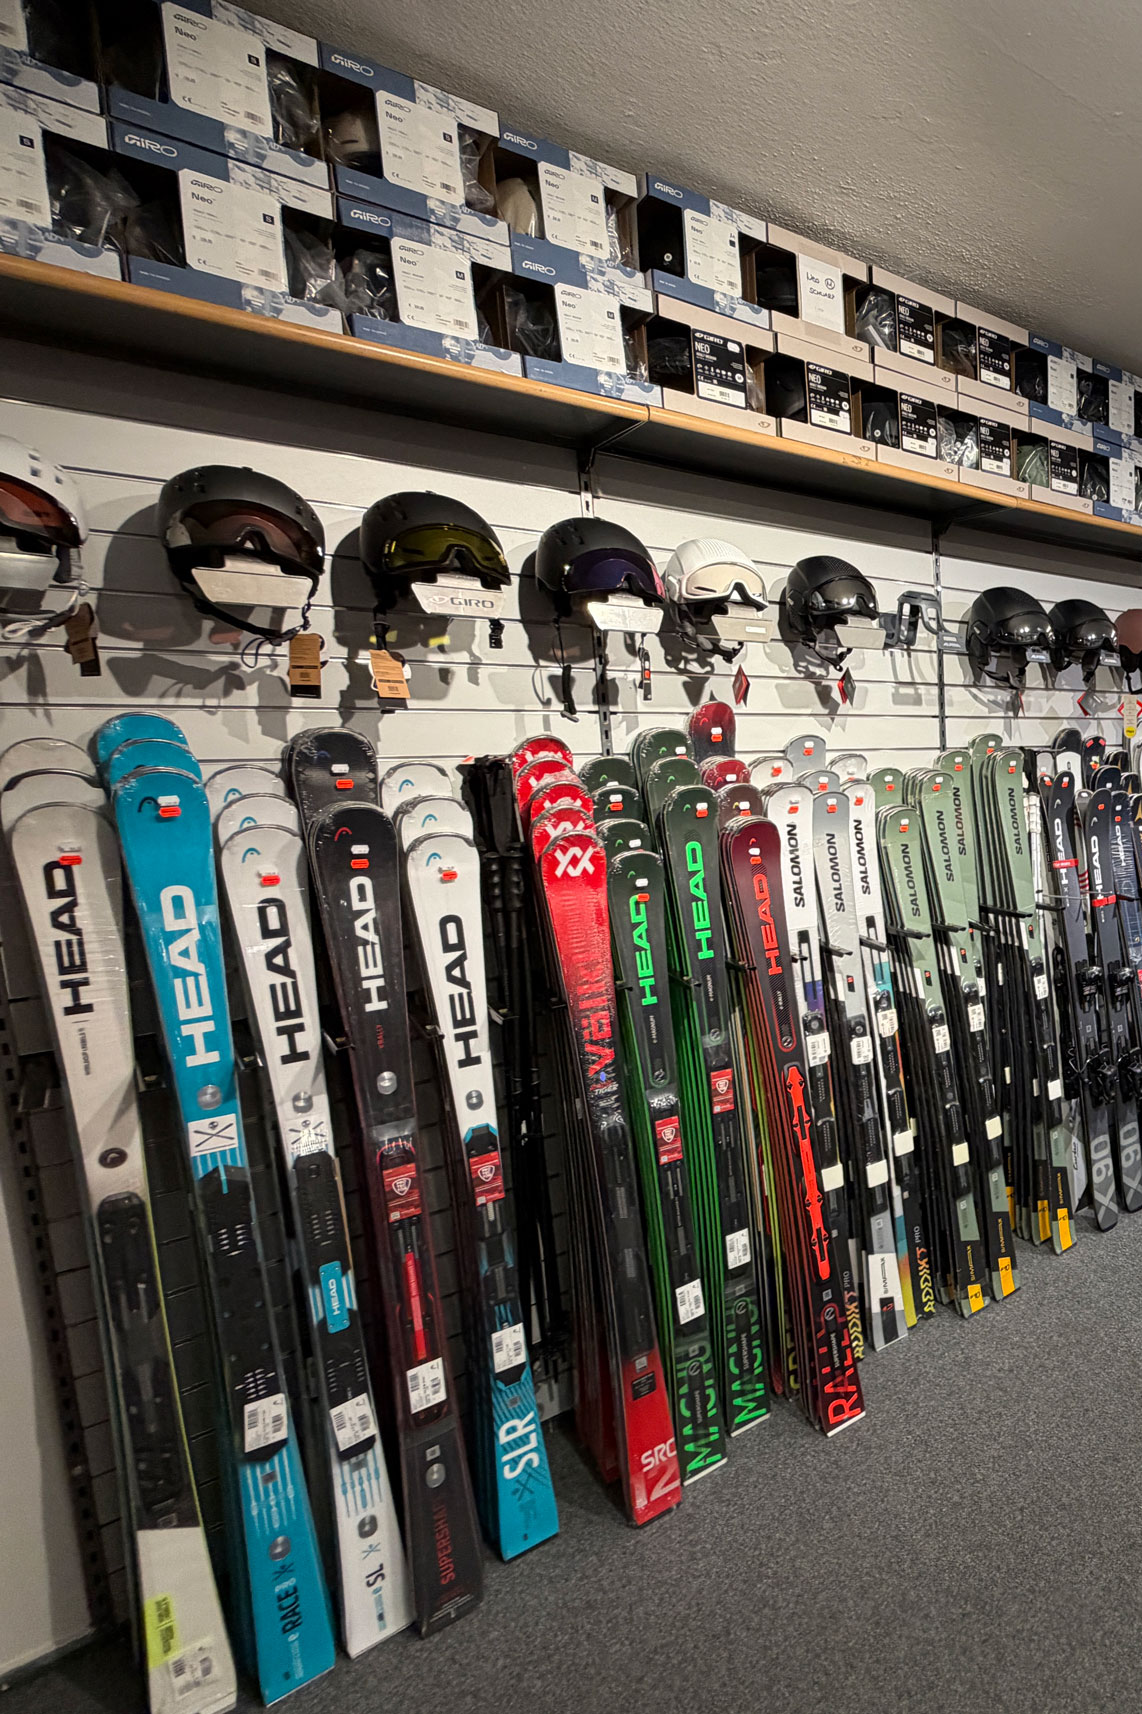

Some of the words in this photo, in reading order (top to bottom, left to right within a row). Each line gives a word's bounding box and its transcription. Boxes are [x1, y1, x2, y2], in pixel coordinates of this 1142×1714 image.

[173, 13, 208, 31] GIRO
[174, 26, 197, 42] Neo
[331, 54, 374, 77] GIRO
[385, 111, 403, 123] Neo
[124, 133, 179, 158] GIRO
[503, 131, 537, 151] GIRO
[190, 179, 225, 195] GIRO
[545, 179, 561, 190] Neo
[654, 182, 684, 199] GIRO
[191, 191, 214, 205] Neo
[350, 209, 392, 228] GIRO
[399, 244, 425, 257] GIRO
[400, 256, 417, 267] Neo
[522, 260, 556, 276] GIRO
[560, 289, 582, 300] GIRO
[561, 300, 577, 309] Neo
[694, 341, 711, 354] NEO
[808, 372, 822, 385] NEO
[901, 402, 913, 413] NEO
[450, 597, 495, 609] GIRO
[953, 787, 967, 856] SALOMON
[1007, 787, 1024, 855] SALOMON
[853, 819, 871, 896] SALOMON
[936, 810, 955, 882] SALOMON
[787, 824, 806, 908] SALOMON
[826, 833, 846, 913] SALOMON
[901, 843, 922, 918] SALOMON
[686, 840, 714, 960] HEAD
[753, 872, 783, 976] HEAD
[43, 860, 95, 1017] HEAD
[349, 875, 389, 1013] HEAD
[630, 894, 658, 1006] HEAD
[159, 884, 222, 1069] HEAD
[256, 897, 311, 1065] HEAD
[439, 913, 482, 1069] HEAD
[913, 1226, 921, 1243] PRO
[842, 1270, 850, 1288] PRO
[328, 1278, 341, 1316] HEAD
[499, 1411, 540, 1480] SLR
[641, 1437, 677, 1473] SRC
[432, 1498, 456, 1585] SUPERSHA
[365, 1563, 386, 1588] SL
[276, 1585, 303, 1636] RACE
